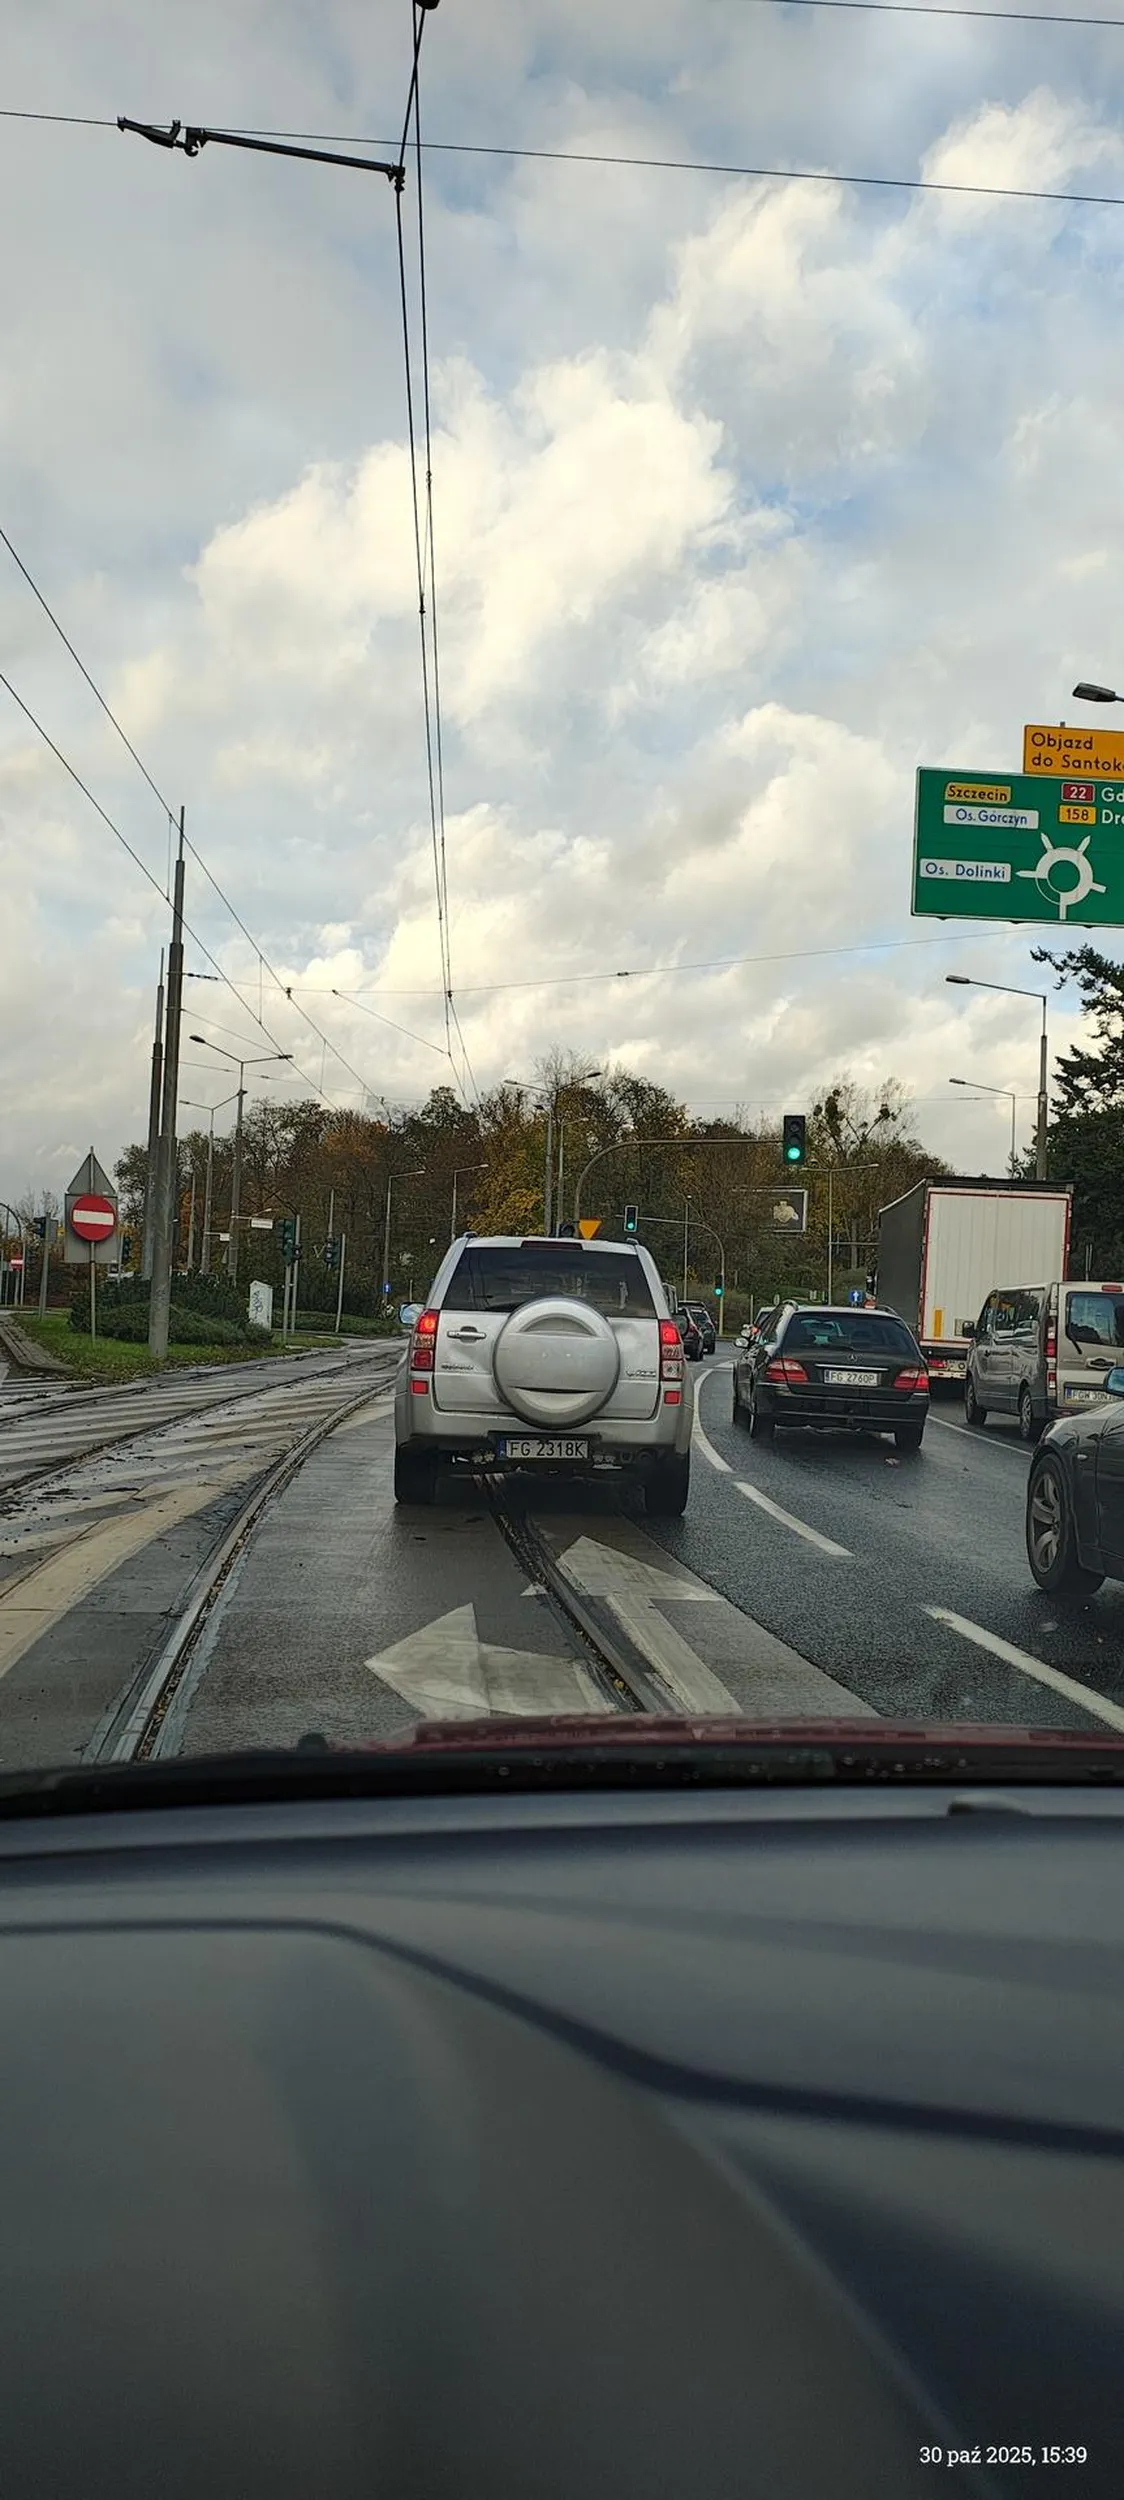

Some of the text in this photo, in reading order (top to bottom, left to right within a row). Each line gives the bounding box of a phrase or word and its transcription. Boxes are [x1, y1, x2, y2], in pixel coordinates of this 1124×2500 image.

[1031, 732, 1093, 752] Objazd
[1032, 752, 1053, 767] do
[947, 785, 1008, 801] Szczecin
[1070, 786, 1087, 799] 22
[956, 808, 976, 821] Os.
[1066, 808, 1089, 821] 158
[925, 862, 1005, 879] Os. Dolinki
[831, 1371, 844, 1382] FG
[510, 1441, 587, 1458] FG 2318K
